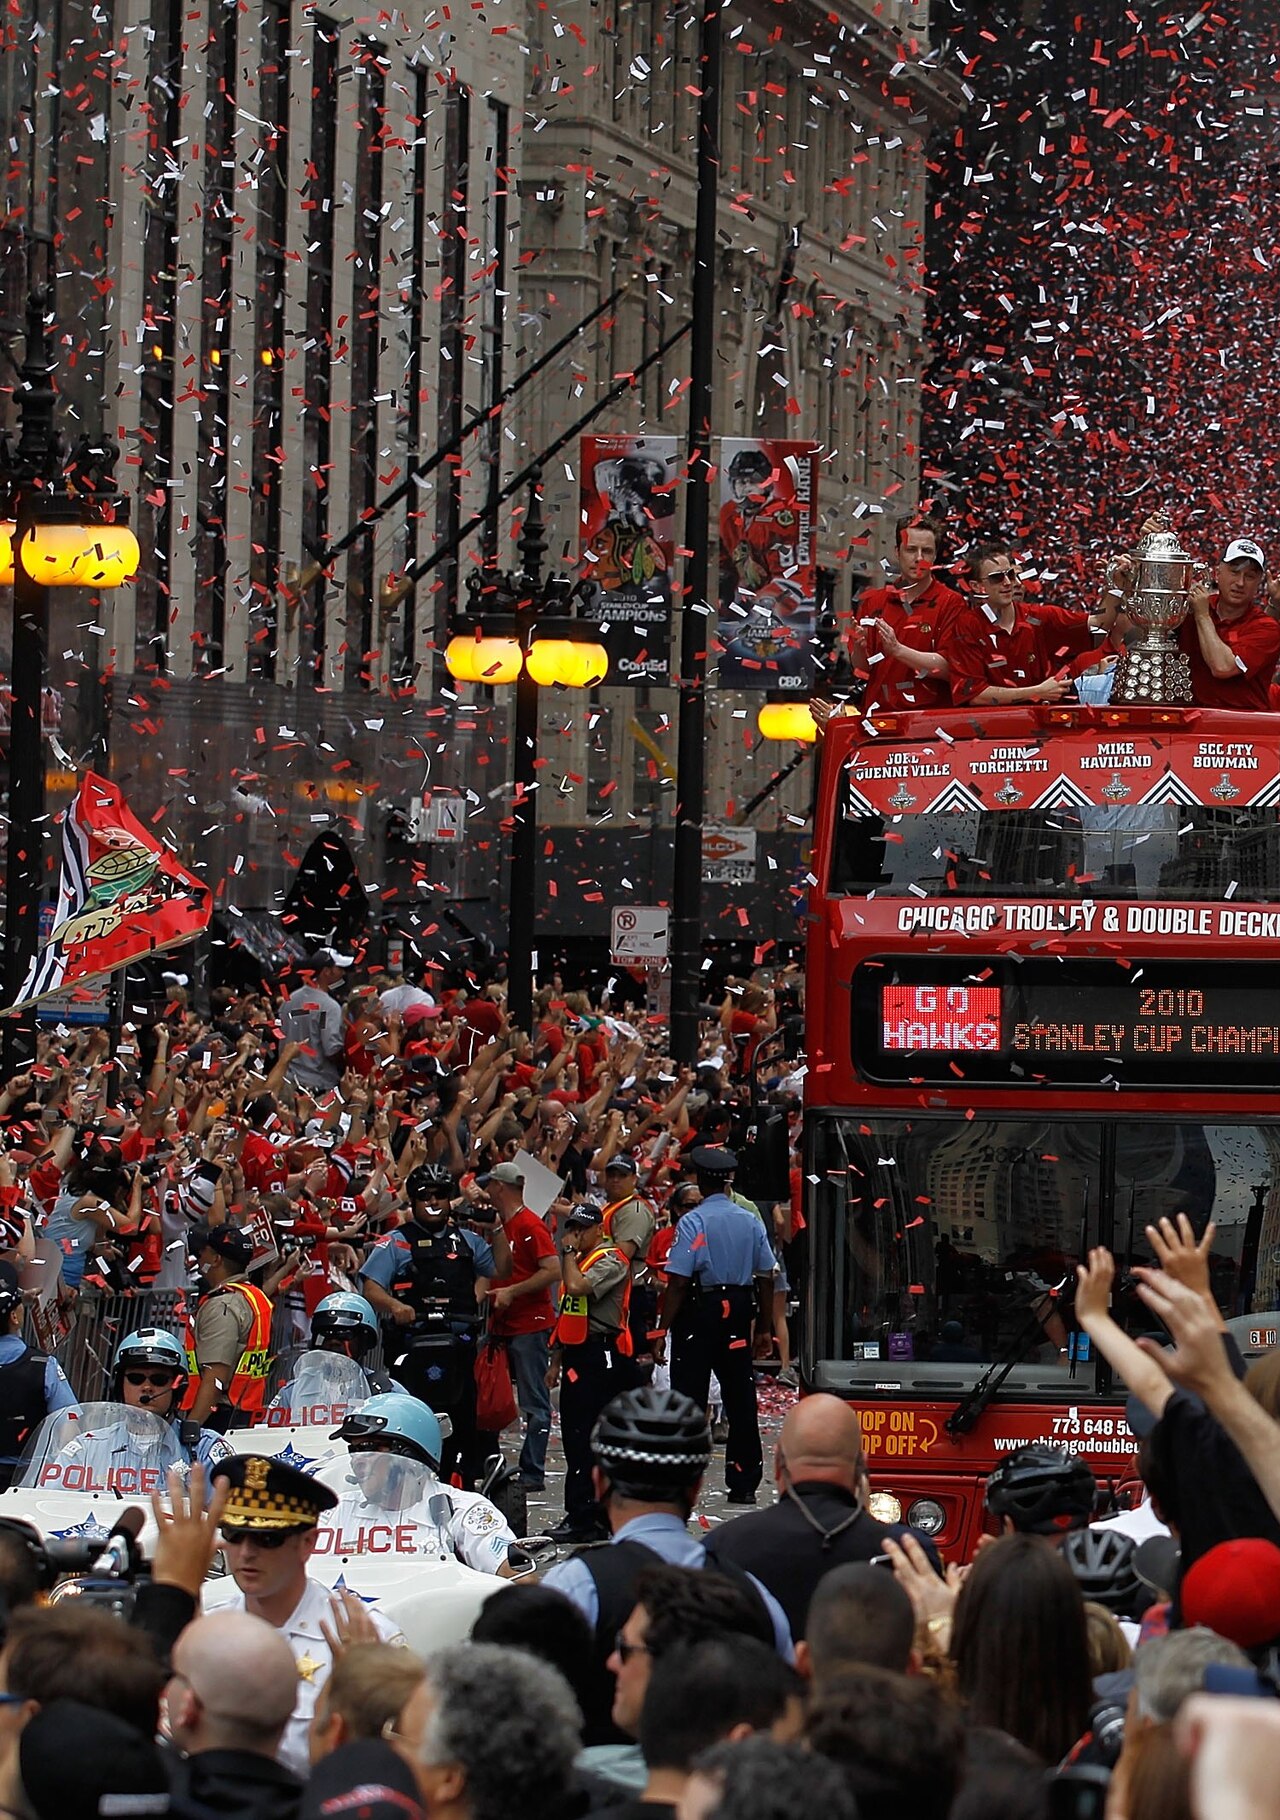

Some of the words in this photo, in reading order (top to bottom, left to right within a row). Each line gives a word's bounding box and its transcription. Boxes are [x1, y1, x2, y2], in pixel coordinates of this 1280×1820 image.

[587, 609, 667, 621] HAMPIONS
[618, 658, 667, 672] ComEd
[990, 747, 1027, 760] JOHN
[1097, 742, 1135, 755] MIKE
[969, 759, 1049, 774] TORCHETTI
[1080, 755, 1152, 769] HAVILAND
[1193, 756, 1258, 769] BOWMAN
[855, 764, 950, 781] QUENNEVILLE
[898, 905, 997, 932] CHICAGO
[1003, 904, 1097, 932] TROLLEY
[1102, 906, 1120, 932] &
[1127, 906, 1213, 935] DOUBLE
[915, 986, 968, 1013] GO
[1140, 989, 1204, 1017] 2010
[883, 1021, 997, 1050] HAWKS
[1014, 1023, 1125, 1051] STANLEY
[1133, 1025, 1182, 1052] CUP
[248, 1403, 349, 1428] POLICE
[890, 1411, 915, 1432] ON
[1052, 1418, 1081, 1435] 773
[1083, 1419, 1114, 1435] 648
[861, 1434, 882, 1455] OP
[885, 1434, 918, 1455] OFF
[39, 1463, 160, 1493] POLICE
